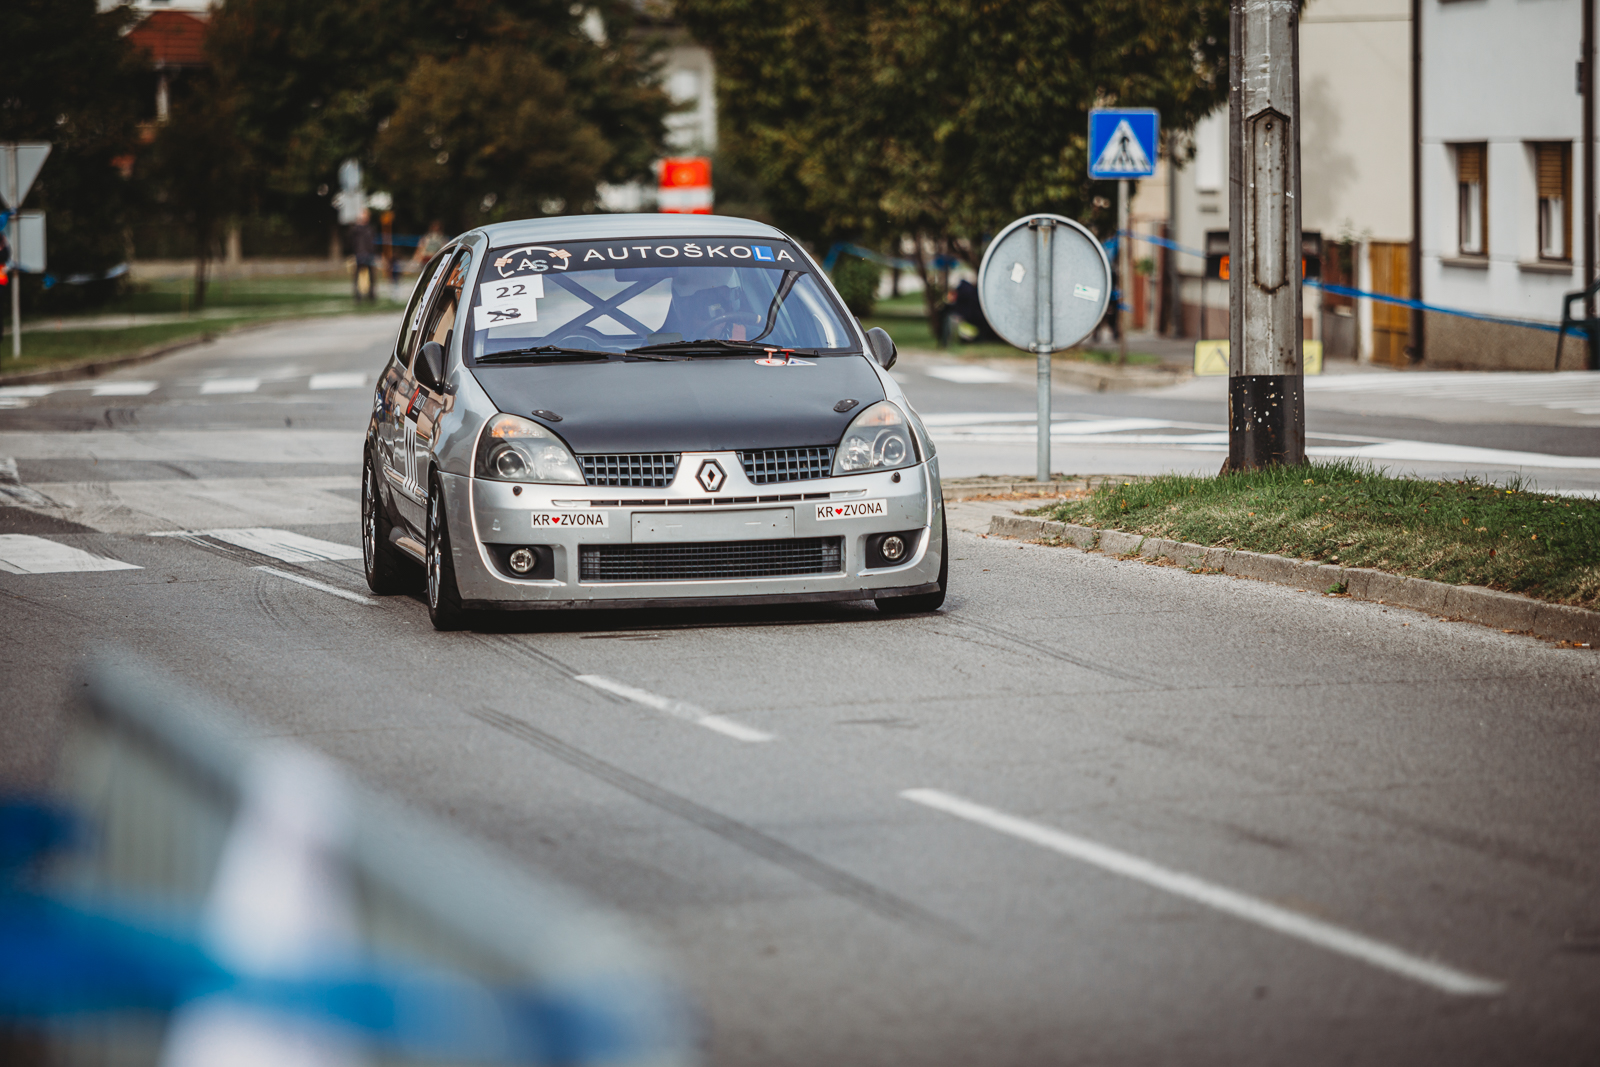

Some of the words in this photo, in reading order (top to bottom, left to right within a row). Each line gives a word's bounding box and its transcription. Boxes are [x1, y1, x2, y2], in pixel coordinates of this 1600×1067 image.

[583, 243, 796, 263] AUTOŠKOLA
[516, 257, 550, 272] AS
[496, 284, 528, 299] 22
